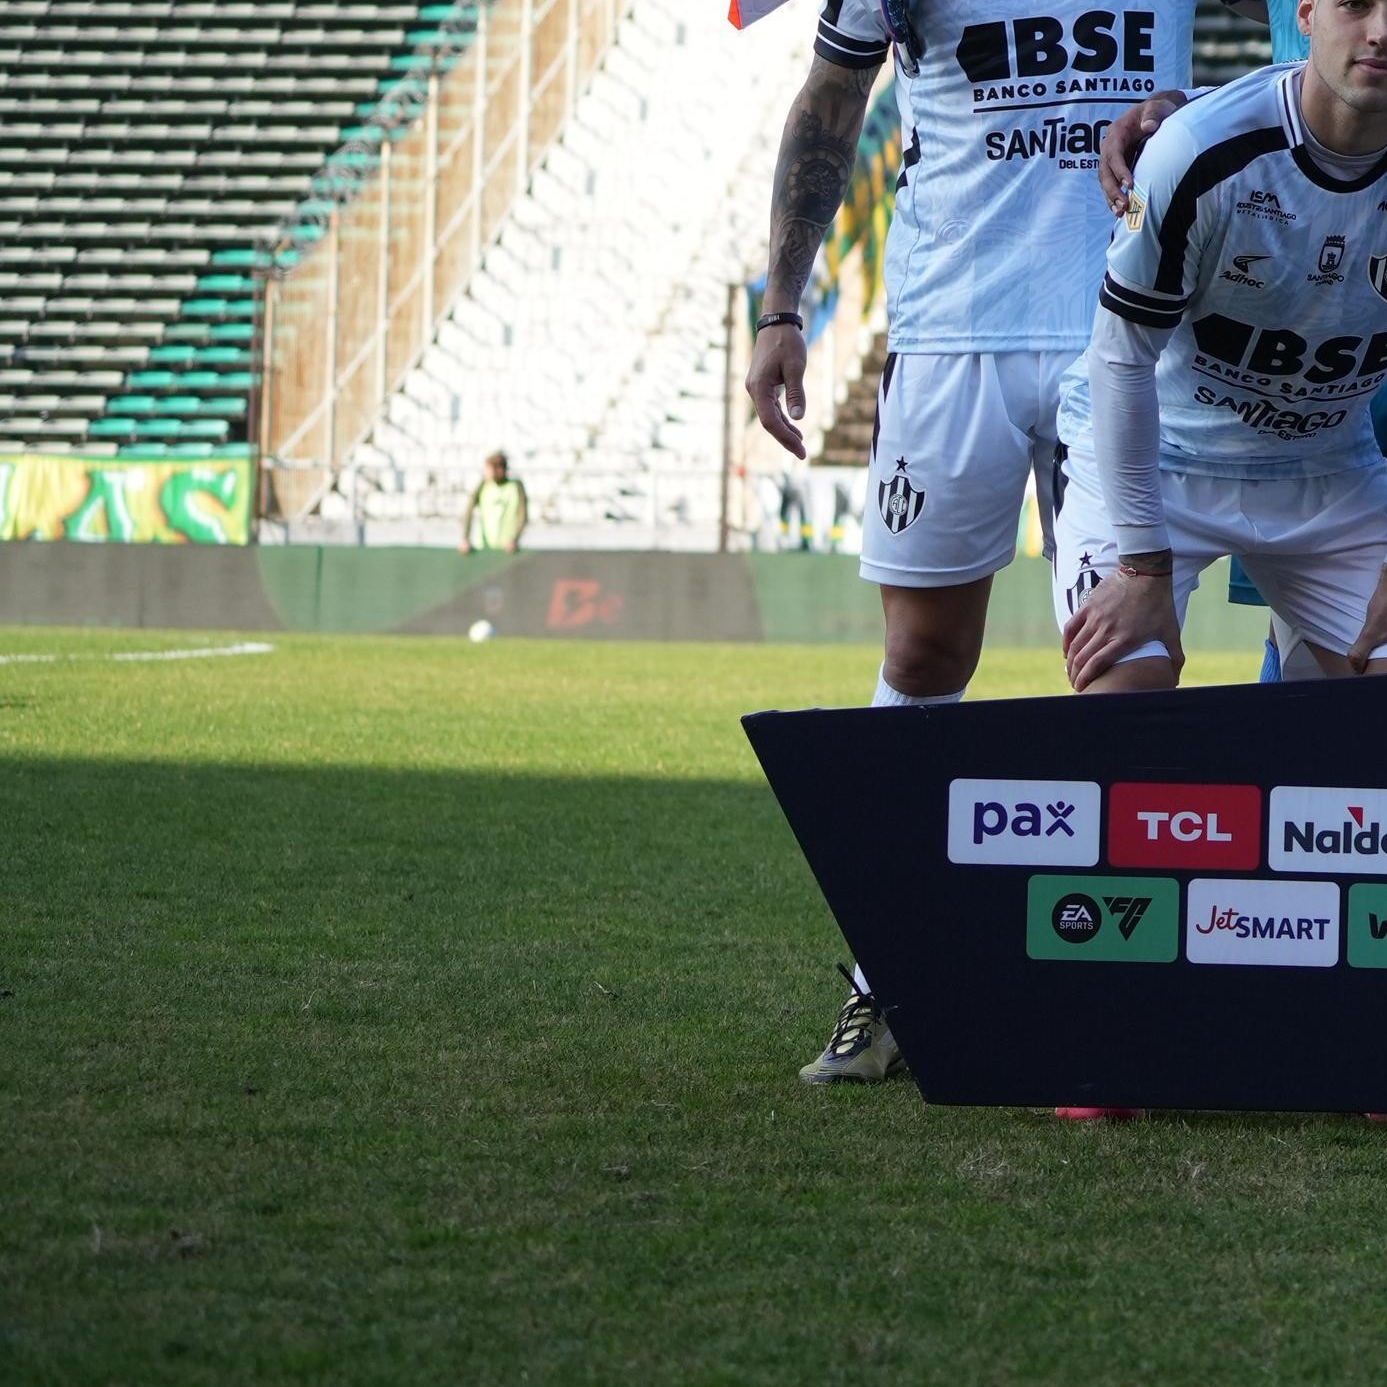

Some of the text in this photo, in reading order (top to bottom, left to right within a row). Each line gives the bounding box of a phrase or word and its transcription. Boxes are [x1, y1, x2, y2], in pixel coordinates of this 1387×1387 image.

[1013, 10, 1155, 78] BSE
[973, 78, 1155, 102] BANCO SANTIAGO
[1250, 191, 1281, 209] ISM
[1219, 270, 1265, 289] Adhoc
[1194, 355, 1385, 397] BANCO SANTIAGO
[973, 801, 1075, 844] pax
[1137, 812, 1232, 841] TCL
[1060, 920, 1093, 929] SPORTS
[1061, 905, 1091, 920] EA
